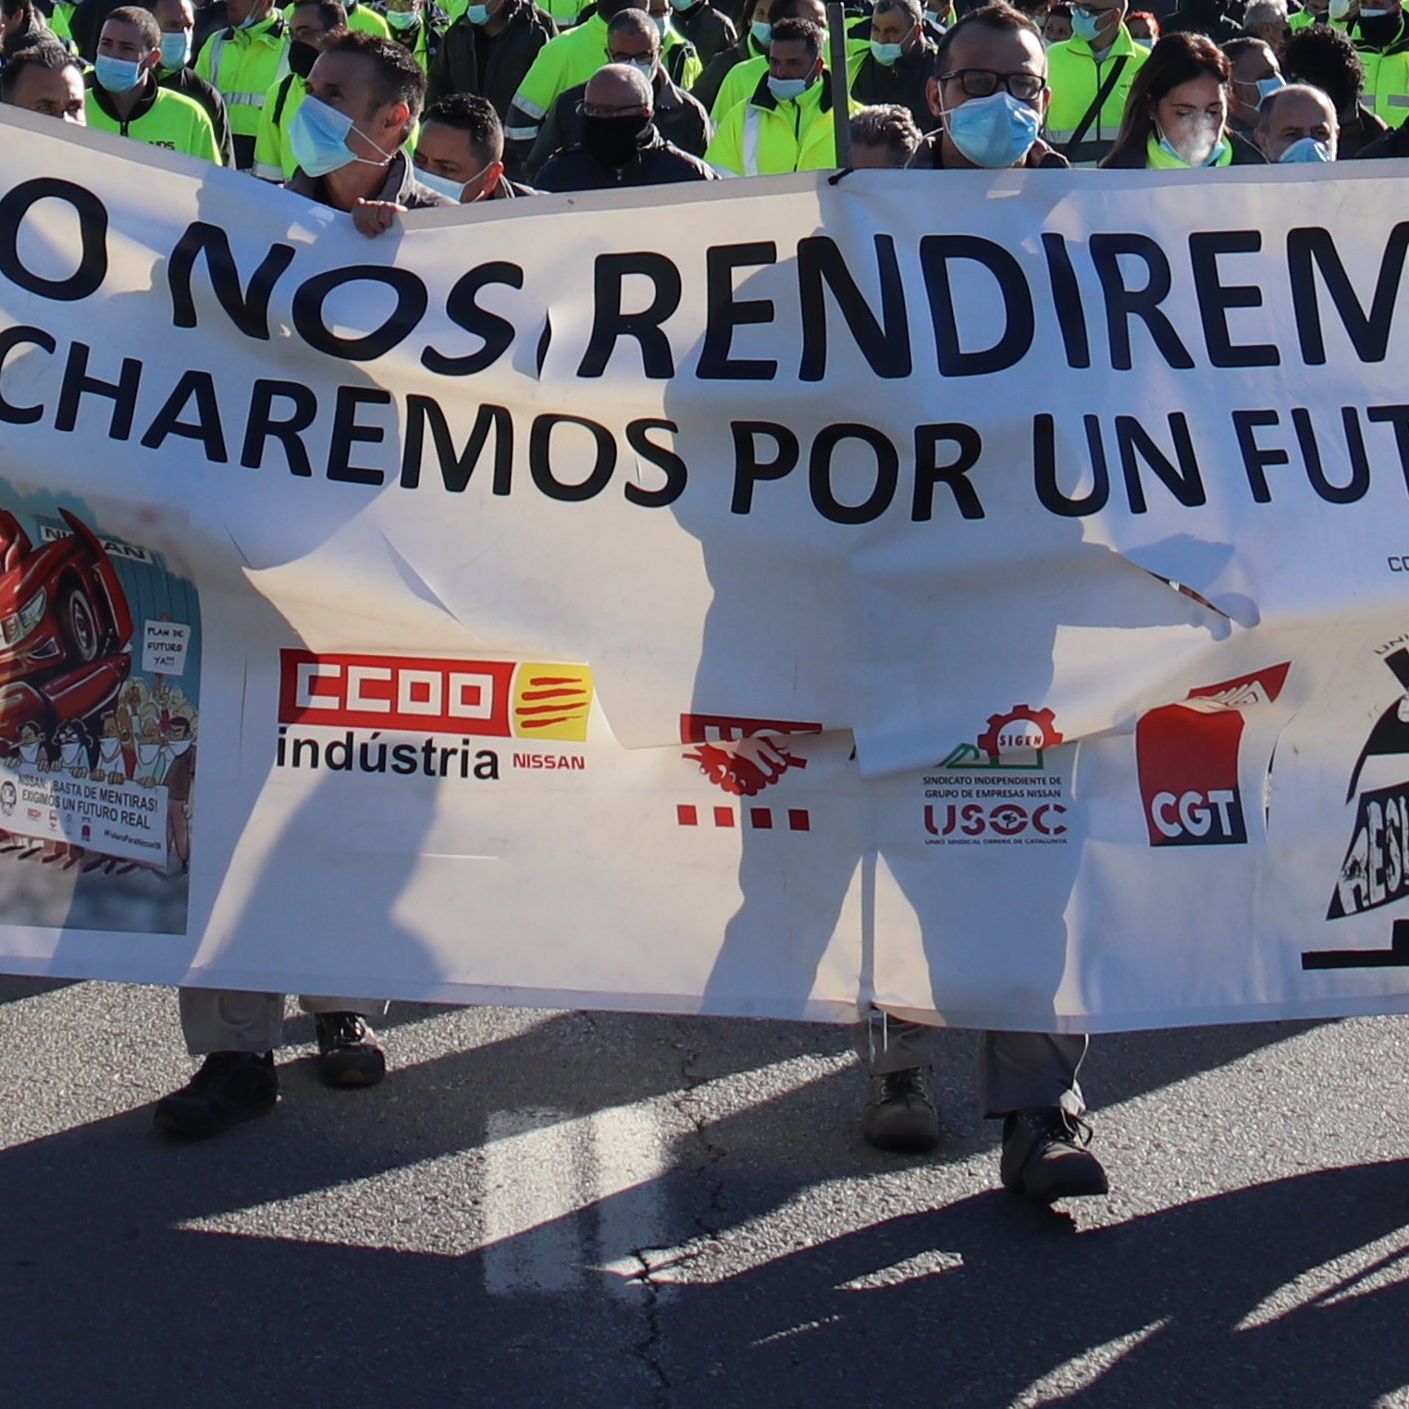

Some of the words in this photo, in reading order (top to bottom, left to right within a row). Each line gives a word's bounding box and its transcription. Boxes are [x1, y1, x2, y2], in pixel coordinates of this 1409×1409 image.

[167, 221, 525, 376] NOS
[729, 420, 987, 526] POR
[1033, 411, 1208, 518] UN
[295, 661, 494, 721] CCOO
[275, 725, 501, 781] indústria
[999, 734, 1043, 748] SIGEN
[512, 751, 586, 771] NISSAN
[84, 785, 97, 800] DE
[99, 788, 158, 813] MENTIRAS!
[923, 775, 973, 786] SINDICATO
[974, 776, 1047, 786] INDEPENDIENTE
[1049, 776, 1062, 786] DE
[924, 789, 959, 799] GRUPO
[961, 789, 974, 799] DE
[976, 789, 1026, 799] EMPRESAS
[1027, 789, 1062, 799] NISSAN
[22, 789, 61, 809] EXIGIMOS
[62, 797, 76, 812] UN
[77, 801, 119, 822] FUTURO
[120, 810, 151, 830] REAL
[923, 803, 1068, 837] USOC
[1151, 789, 1236, 839] CGT
